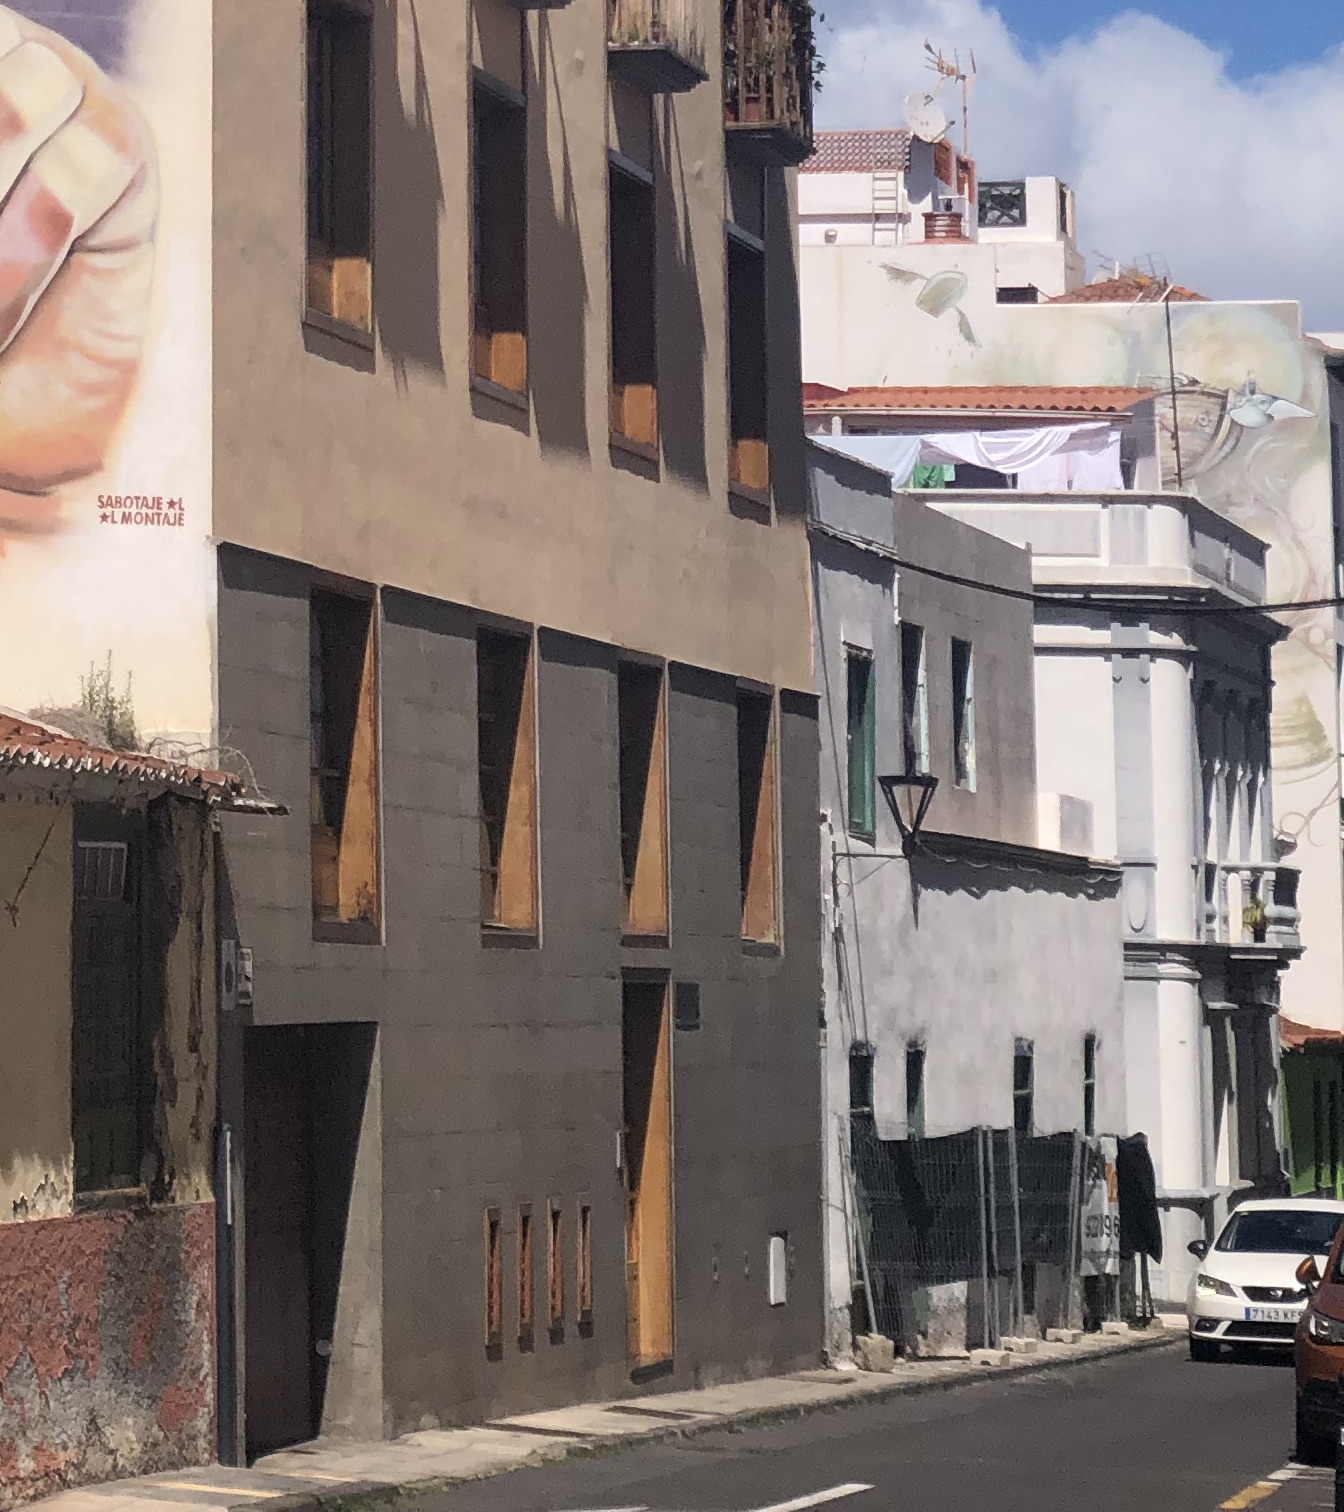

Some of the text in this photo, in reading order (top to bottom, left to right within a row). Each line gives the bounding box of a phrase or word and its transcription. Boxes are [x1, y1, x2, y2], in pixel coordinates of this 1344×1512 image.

[97, 494, 163, 511] SABOTAJE
[120, 510, 185, 526] MONTAJE
[1252, 1308, 1280, 1321] 7143
